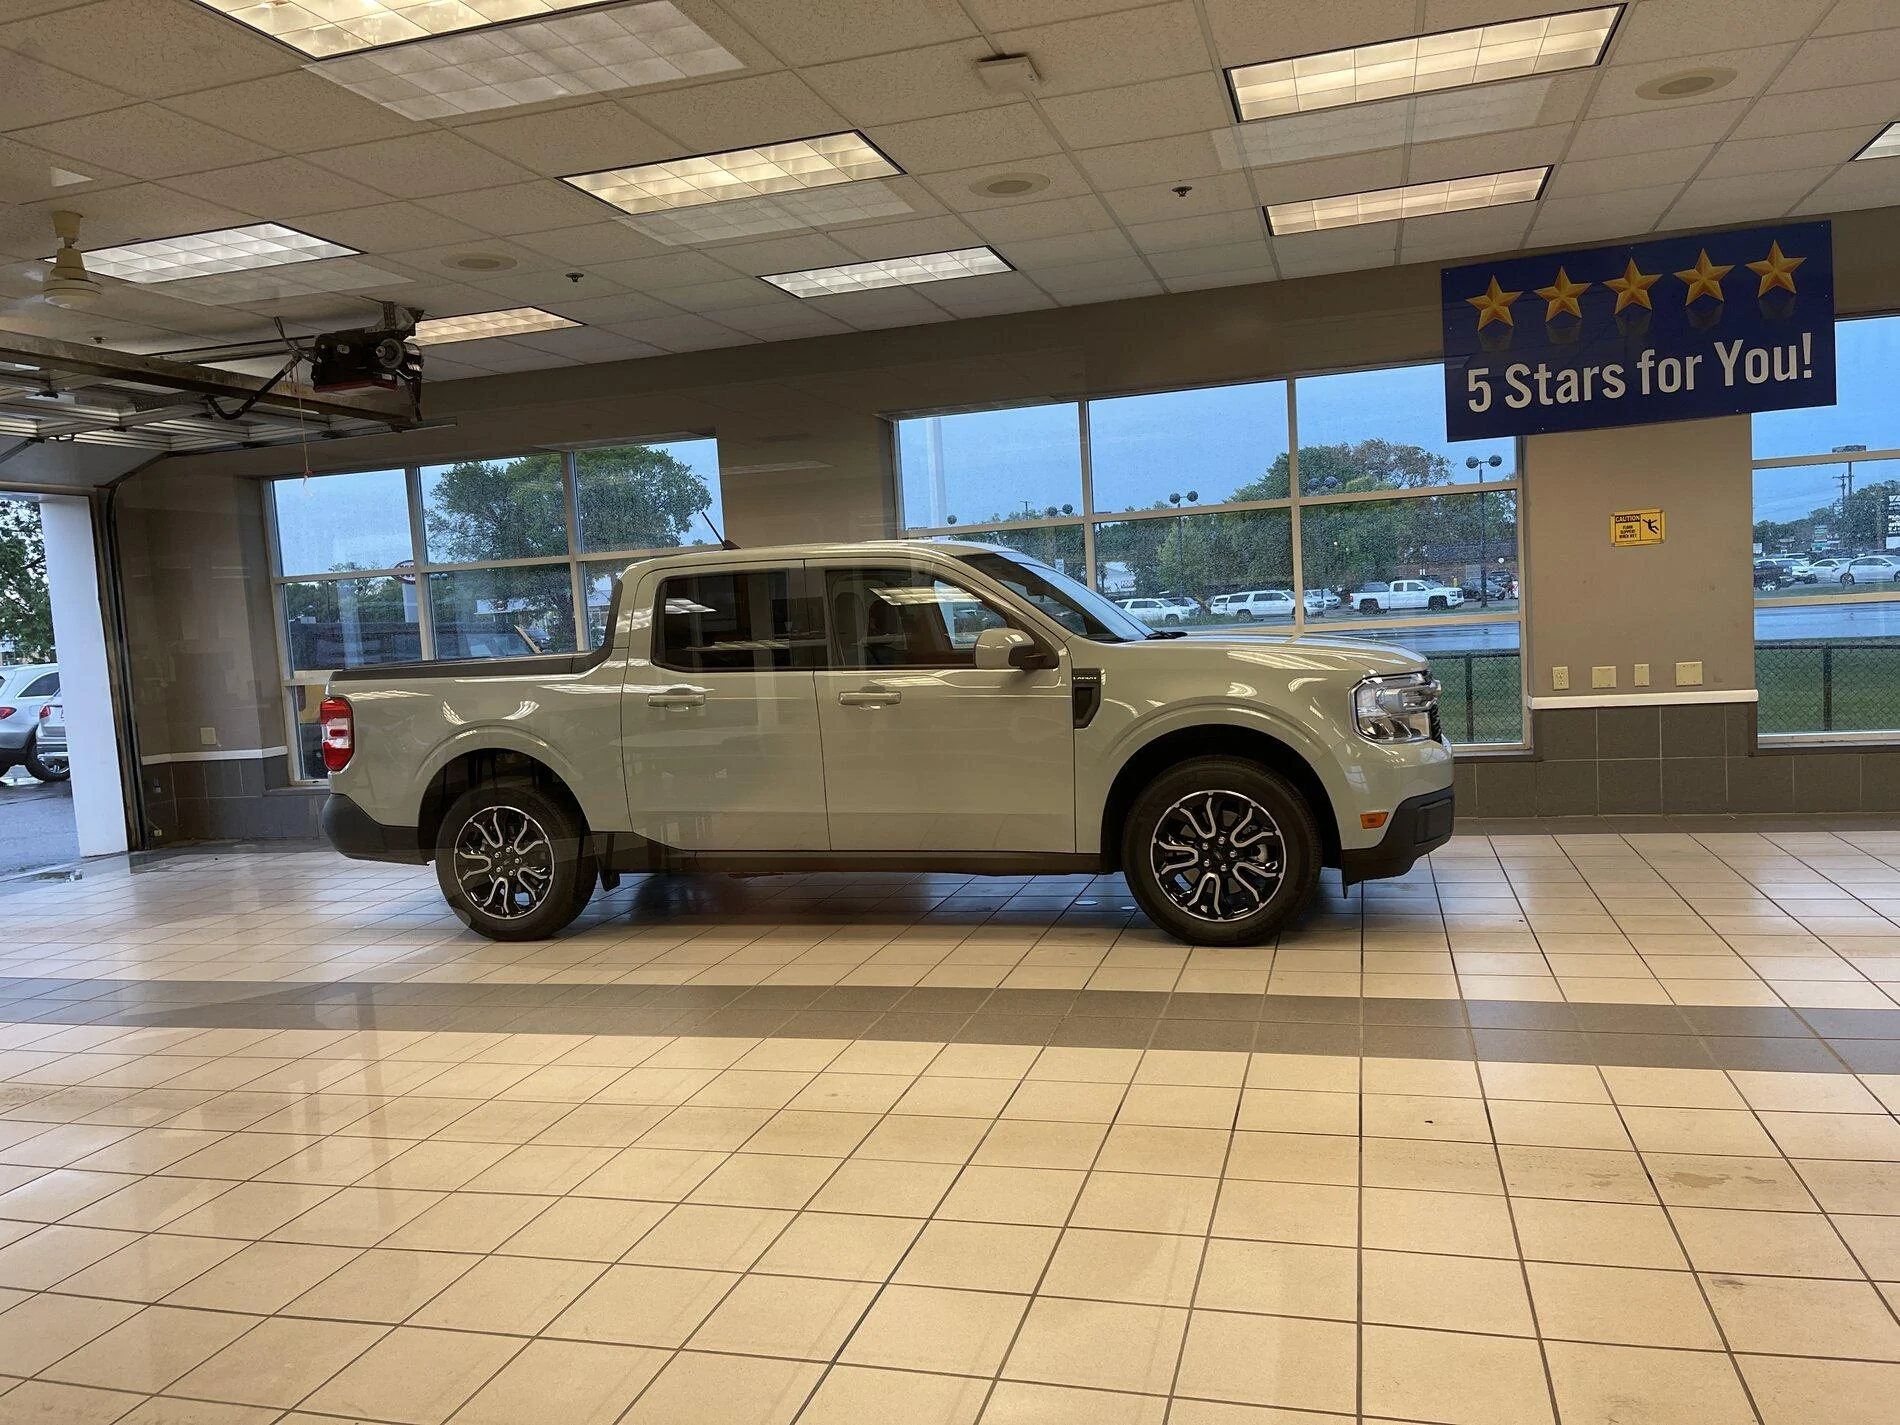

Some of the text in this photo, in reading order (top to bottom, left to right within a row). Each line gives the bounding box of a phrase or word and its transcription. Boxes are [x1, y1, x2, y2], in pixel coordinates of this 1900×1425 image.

[1466, 332, 1813, 413] 5 Stars for You!
